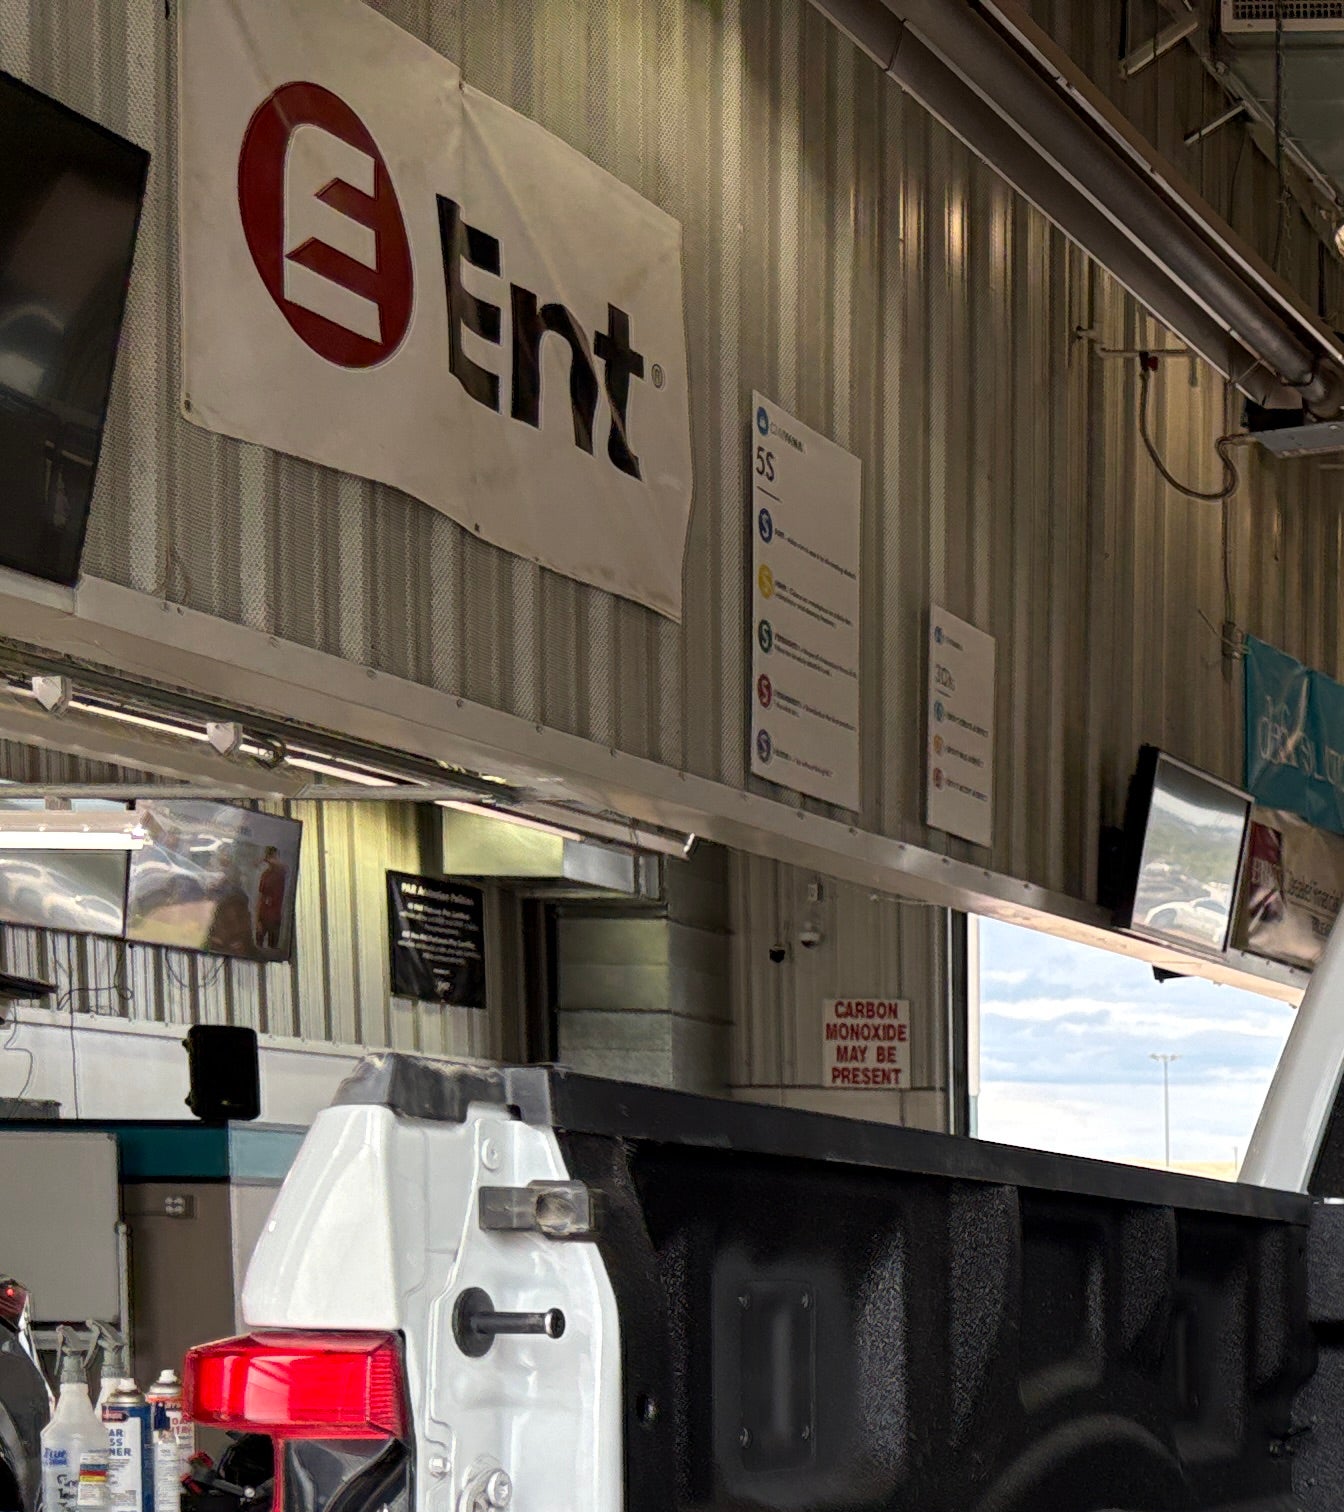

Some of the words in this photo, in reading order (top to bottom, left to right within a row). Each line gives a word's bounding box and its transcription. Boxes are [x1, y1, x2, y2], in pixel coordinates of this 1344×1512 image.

[435, 193, 644, 482] Ent
[756, 446, 775, 482] 5S
[834, 1001, 898, 1019] CARBON
[825, 1023, 907, 1042] MONOXIDE
[836, 1045, 868, 1063] MAY
[876, 1046, 897, 1064] BE
[831, 1066, 902, 1085] PRESENT
